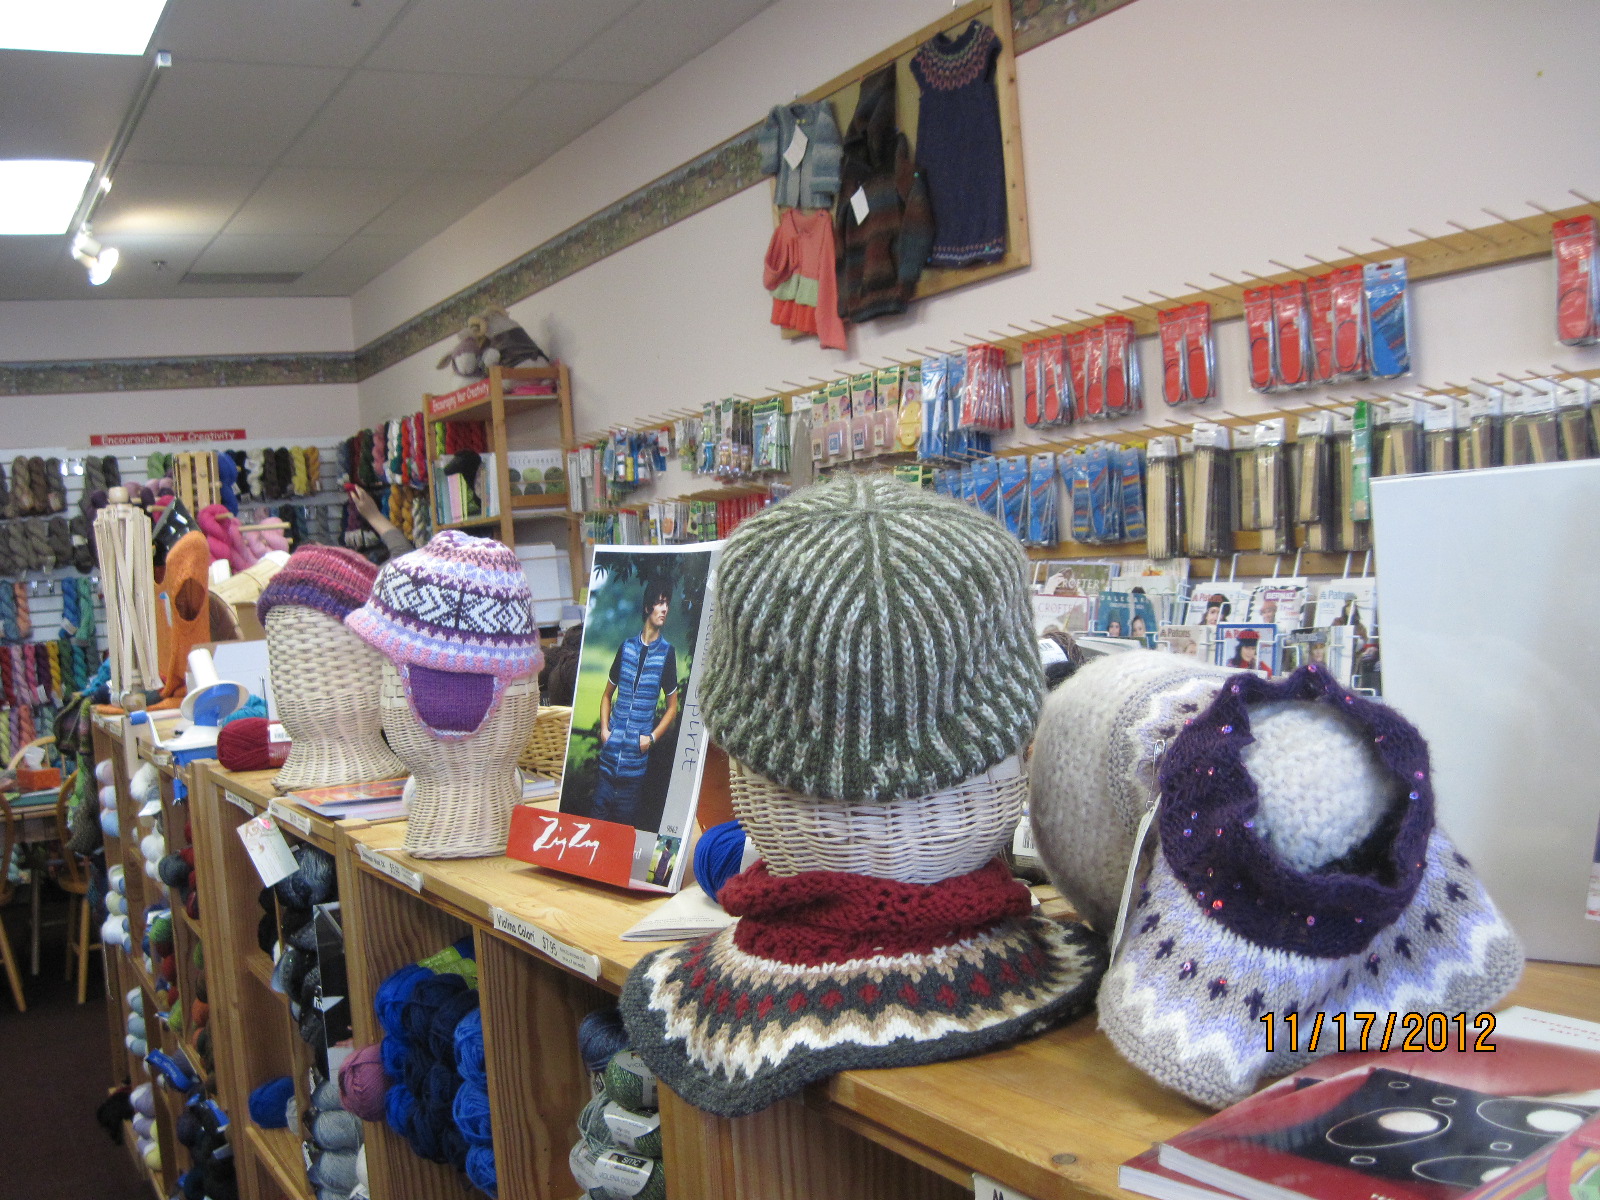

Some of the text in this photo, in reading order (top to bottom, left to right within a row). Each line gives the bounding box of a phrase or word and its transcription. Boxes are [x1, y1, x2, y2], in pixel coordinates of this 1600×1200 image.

[456, 391, 466, 403] Your
[102, 430, 235, 445] Encouraging Your Creativity
[1167, 628, 1191, 638] Patons
